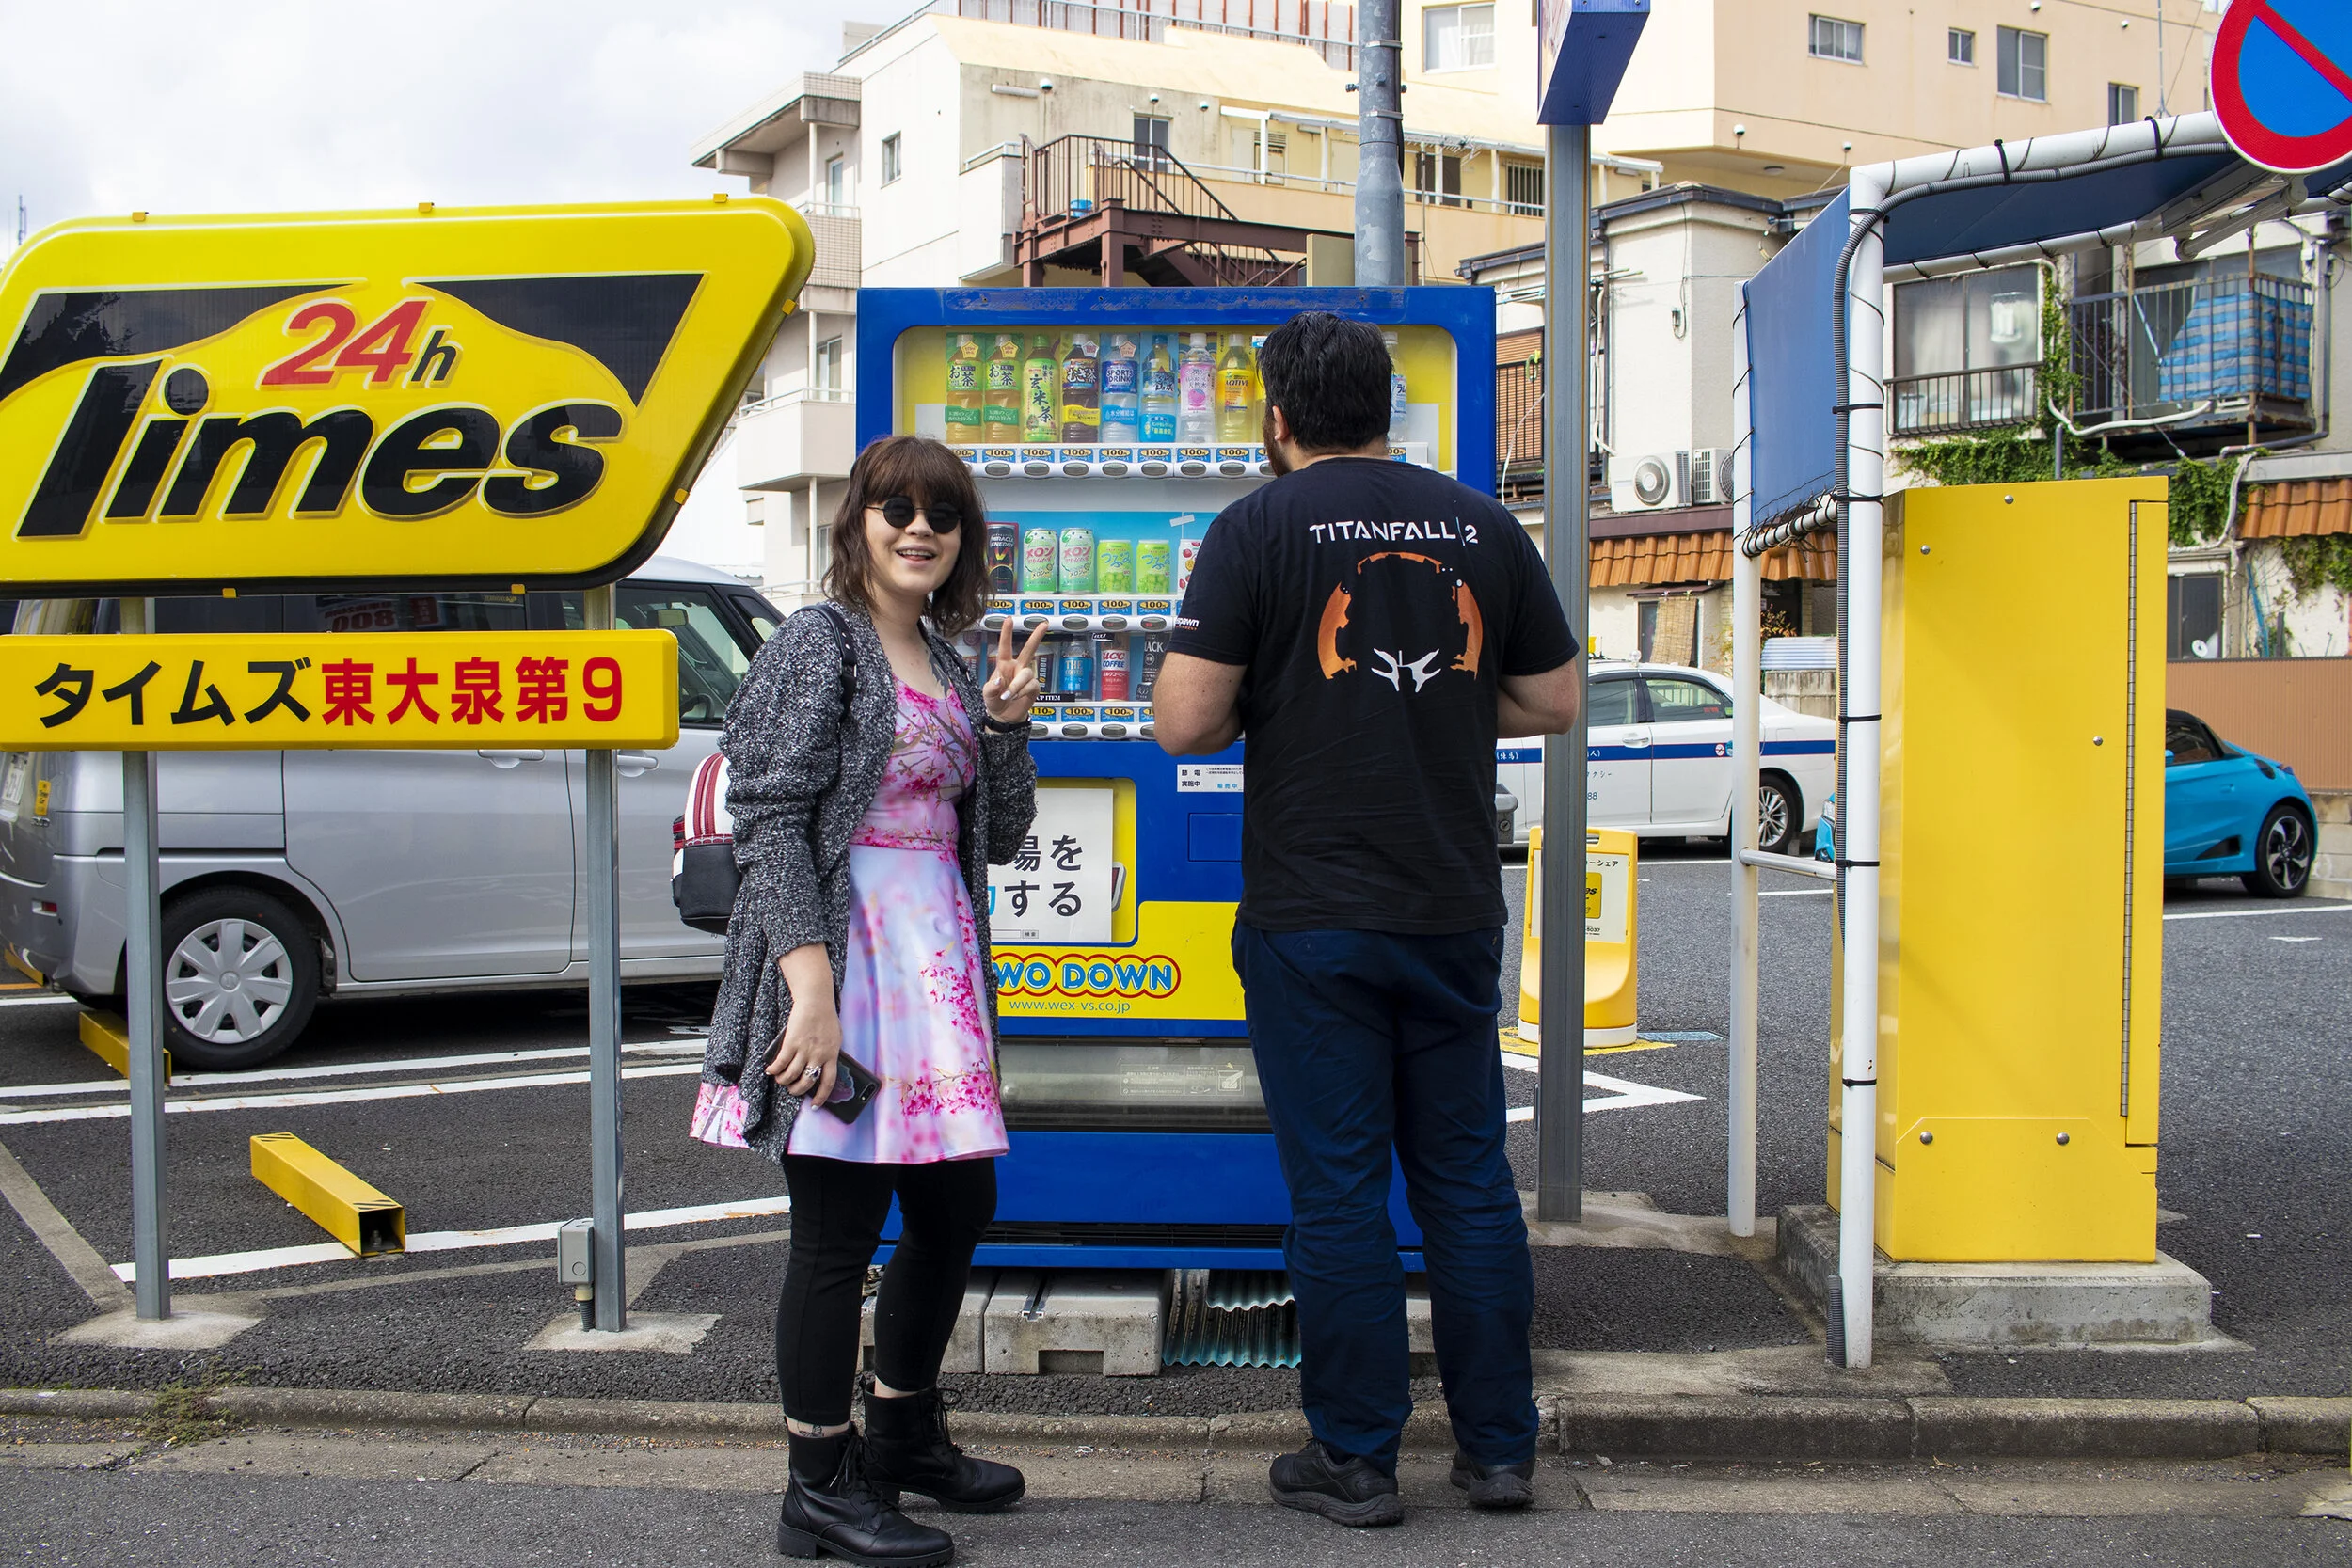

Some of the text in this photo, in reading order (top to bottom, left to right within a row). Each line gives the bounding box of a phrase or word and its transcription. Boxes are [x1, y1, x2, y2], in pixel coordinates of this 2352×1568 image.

[260, 300, 459, 388] 24h
[949, 364, 975, 387] お茶
[988, 364, 1014, 386] お茶
[1067, 368, 1097, 383] むぎ茶
[1106, 369, 1134, 377] SPORTS
[1029, 374, 1053, 423] 玄米茶
[15, 356, 626, 540] Times
[1309, 520, 1456, 544] TITANFALL
[1026, 546, 1055, 558] メロン
[1063, 546, 1092, 558] メロン
[1103, 651, 1126, 660] UCC
[1103, 660, 1125, 669] COFFEE
[34, 656, 623, 729] タイムズ東大泉第9
[988, 879, 1082, 918] する
[1061, 962, 1172, 990] DOWN
[1009, 999, 1132, 1015] www.wex-vs.co.jp
